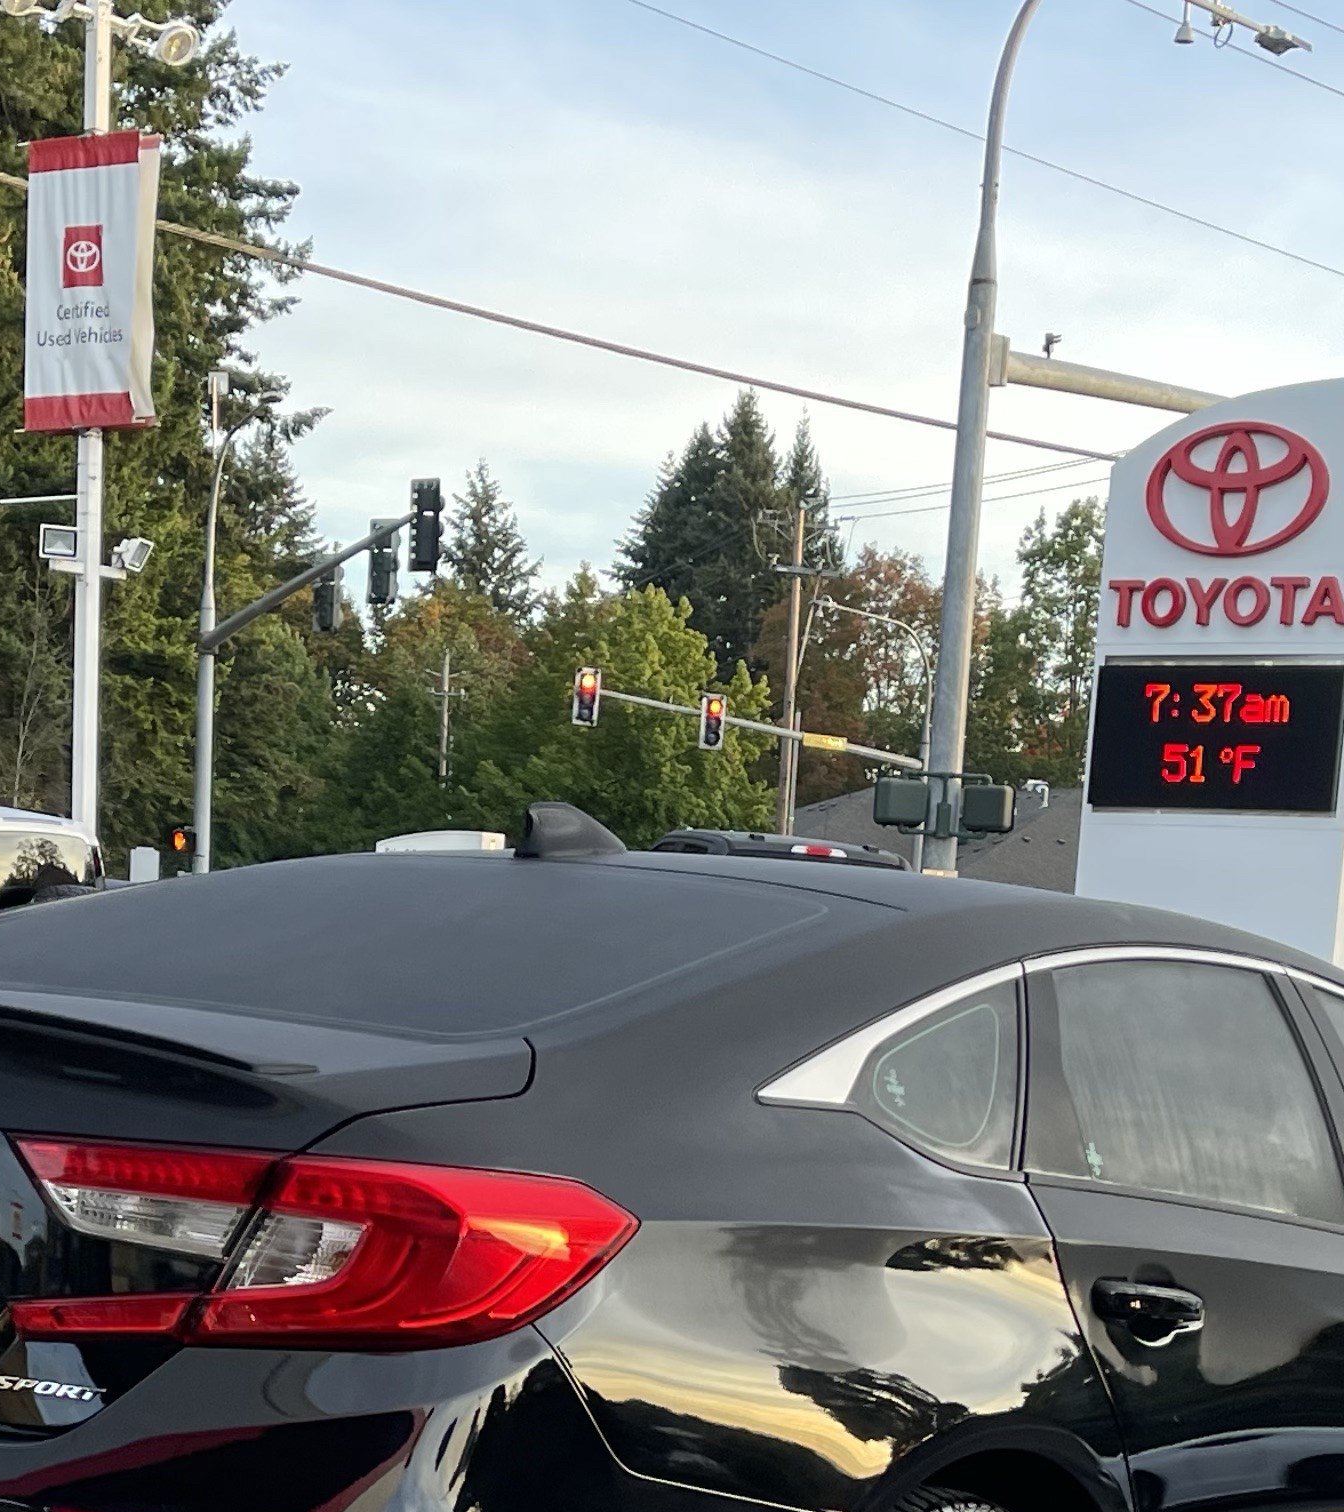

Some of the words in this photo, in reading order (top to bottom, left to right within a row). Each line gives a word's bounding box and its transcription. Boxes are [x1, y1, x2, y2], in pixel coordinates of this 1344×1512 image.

[56, 301, 110, 321] Certified
[37, 329, 71, 347] Used
[74, 325, 123, 344] Vehicles
[1144, 683, 1291, 724] 7:37am
[1160, 743, 1206, 784] 51
